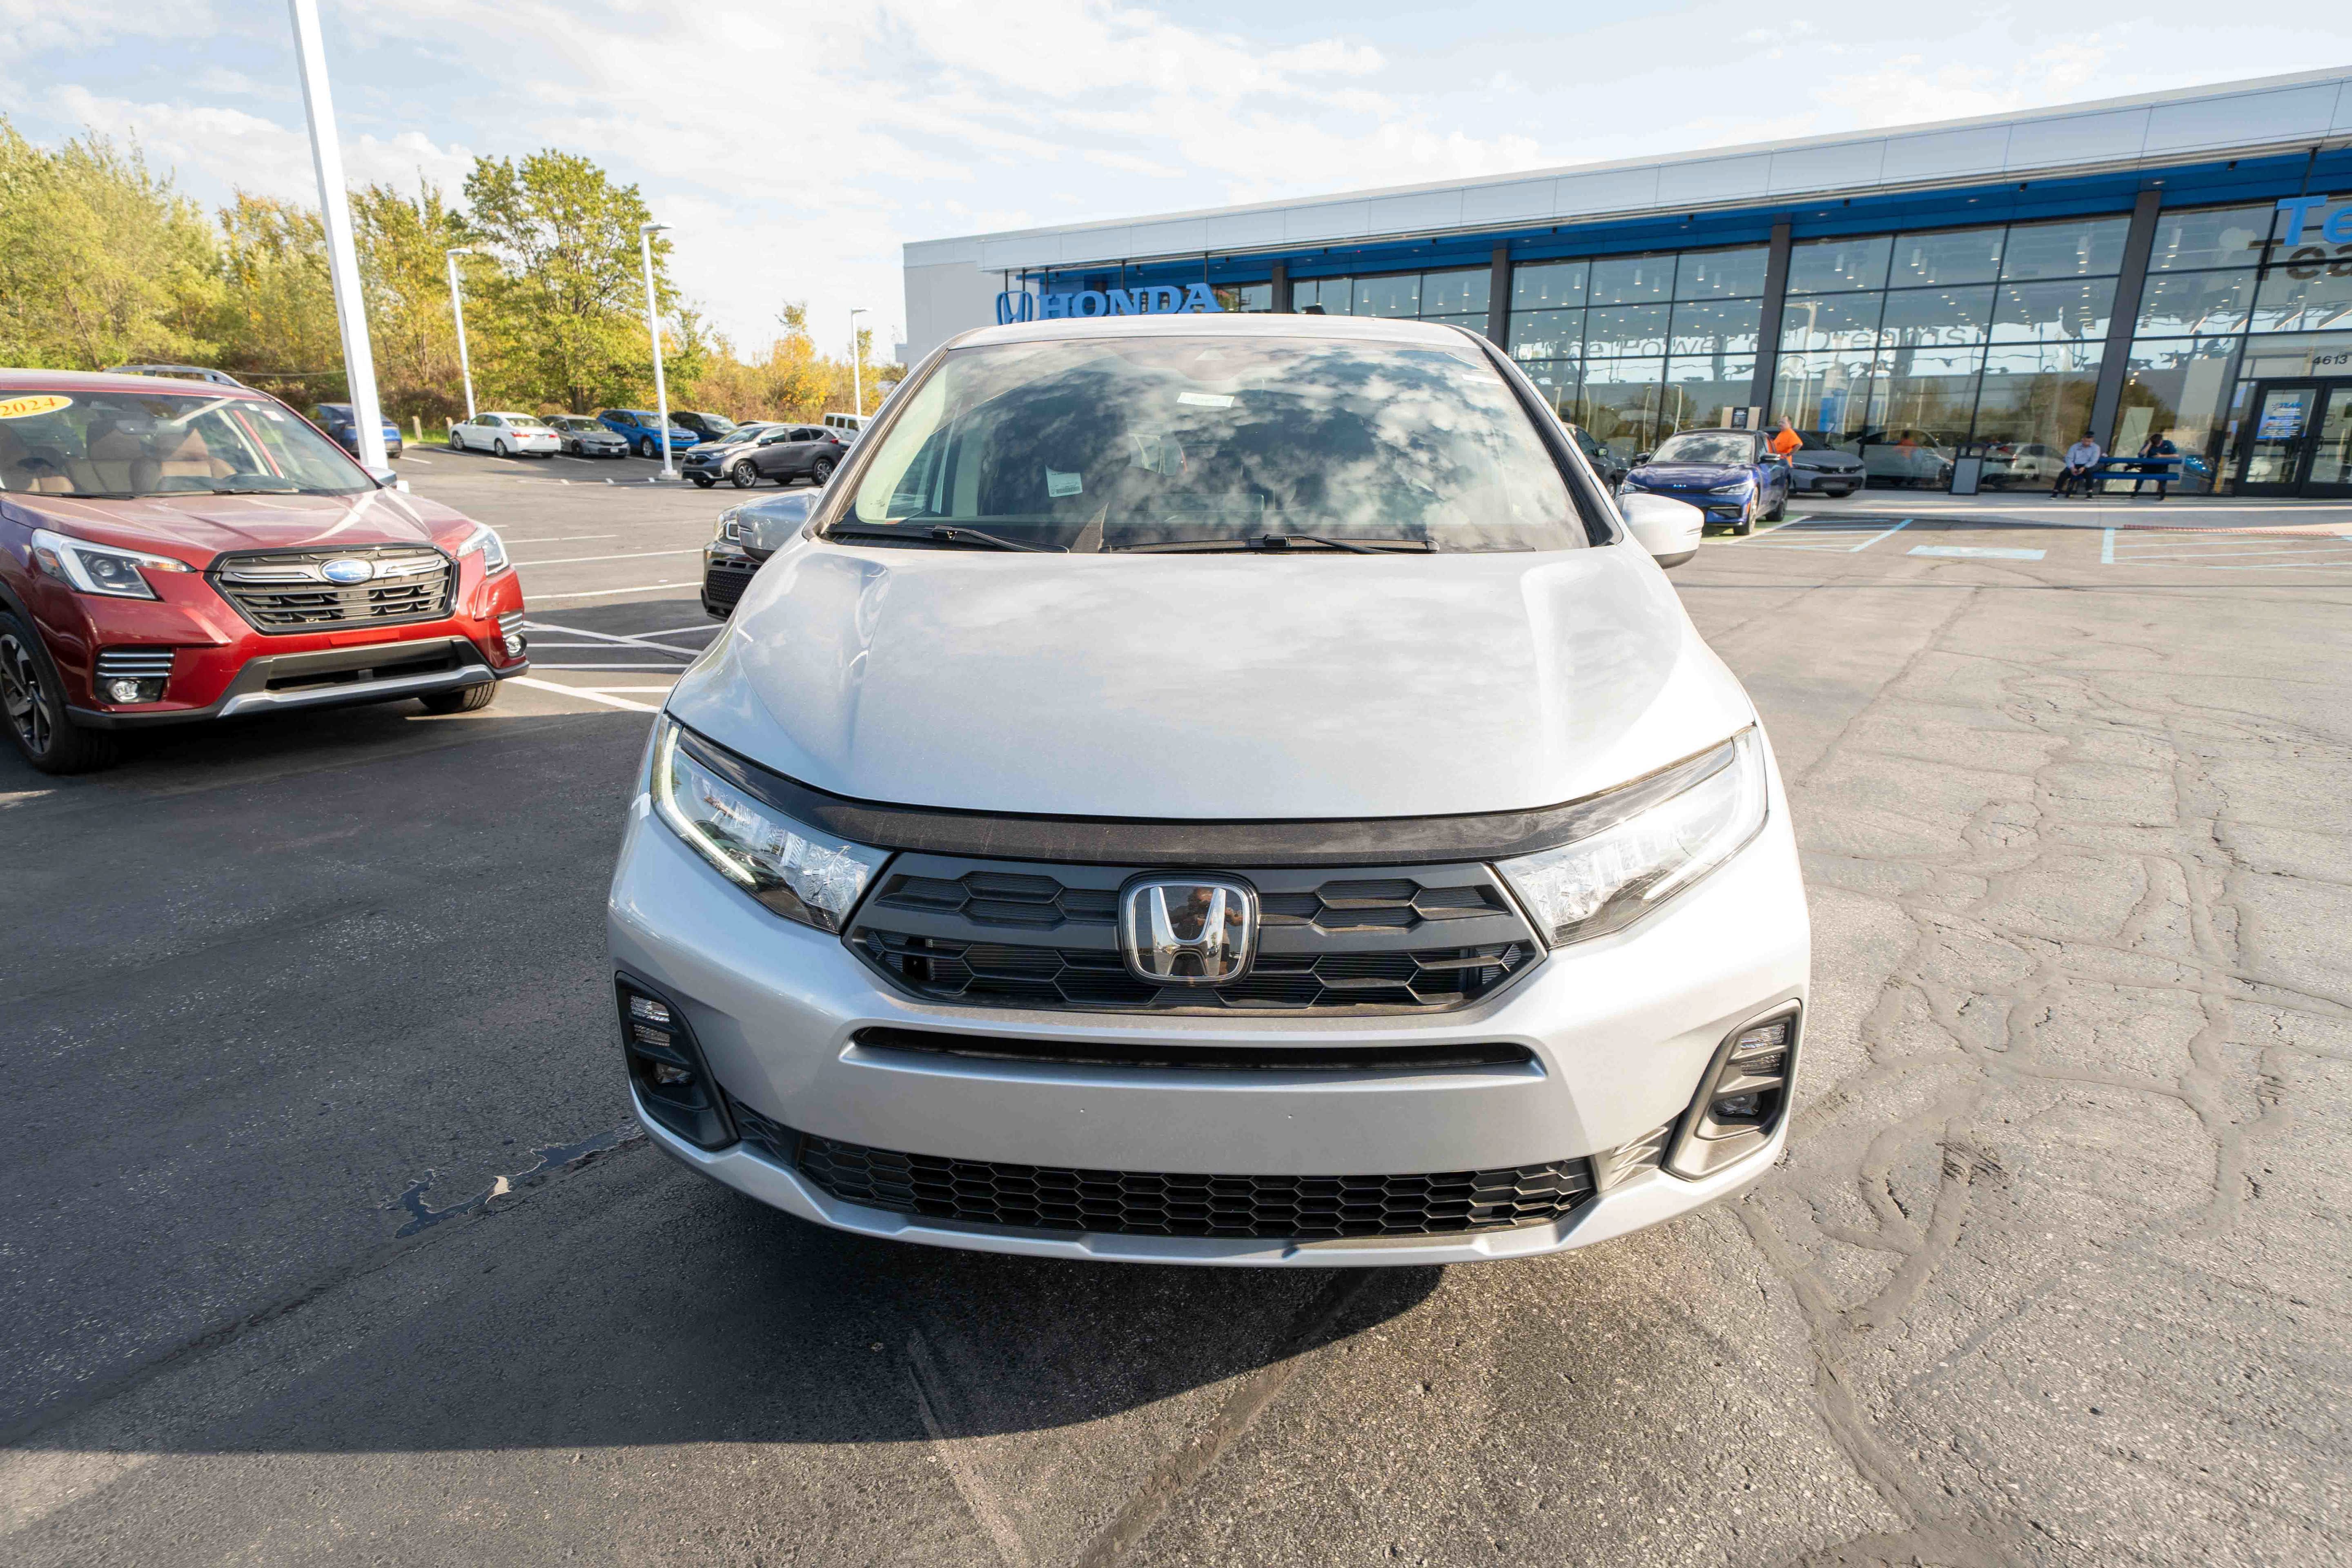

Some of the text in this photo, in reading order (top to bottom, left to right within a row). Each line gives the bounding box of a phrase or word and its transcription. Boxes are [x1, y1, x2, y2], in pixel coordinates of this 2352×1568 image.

[1036, 282, 1224, 320] HONDA
[2312, 354, 2348, 365] 4613
[0, 398, 56, 416] 2024
